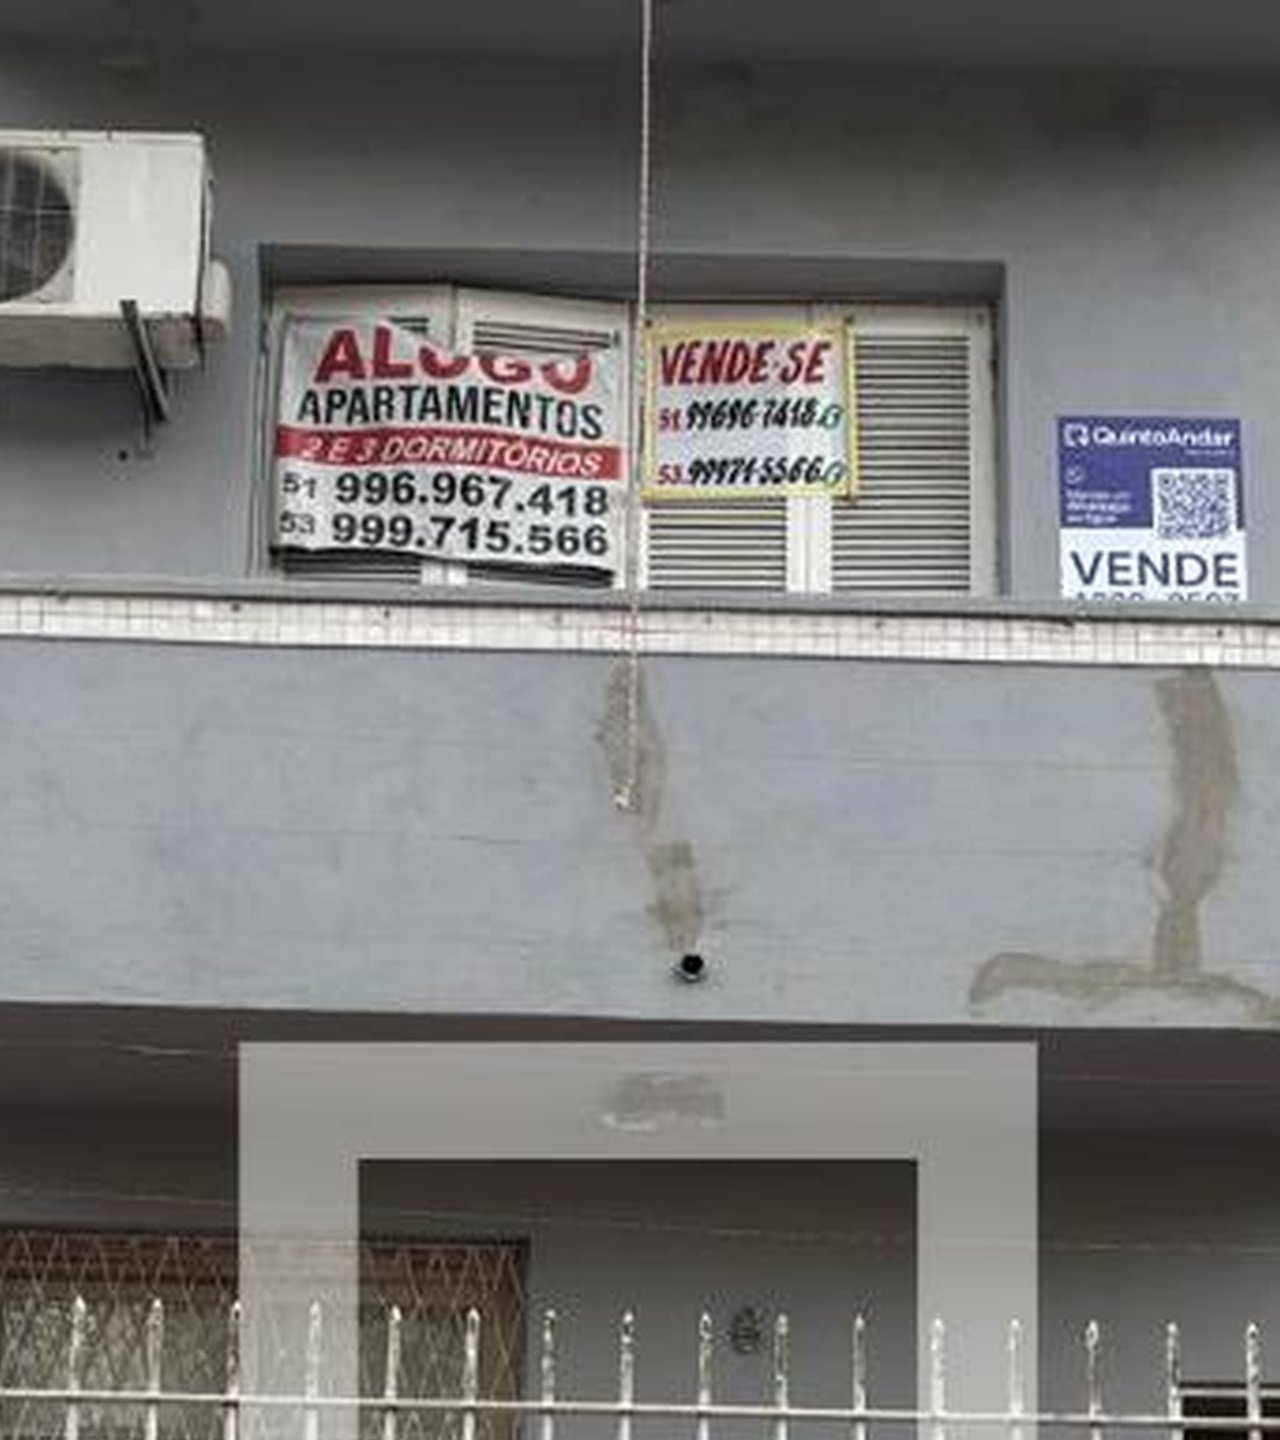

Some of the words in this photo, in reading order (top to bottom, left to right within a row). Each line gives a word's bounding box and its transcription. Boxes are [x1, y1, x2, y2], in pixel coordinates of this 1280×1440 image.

[297, 385, 603, 439] APARTAMENTOS
[301, 436, 322, 458] 2
[326, 437, 351, 462] E
[355, 441, 377, 463] 3
[1092, 427, 1234, 447] QuintoAndar
[282, 471, 317, 499] 51
[335, 471, 609, 518] 996.967.418
[279, 510, 316, 535] 53
[331, 513, 609, 557] 999.715.566
[1070, 551, 1239, 588] VENDE
